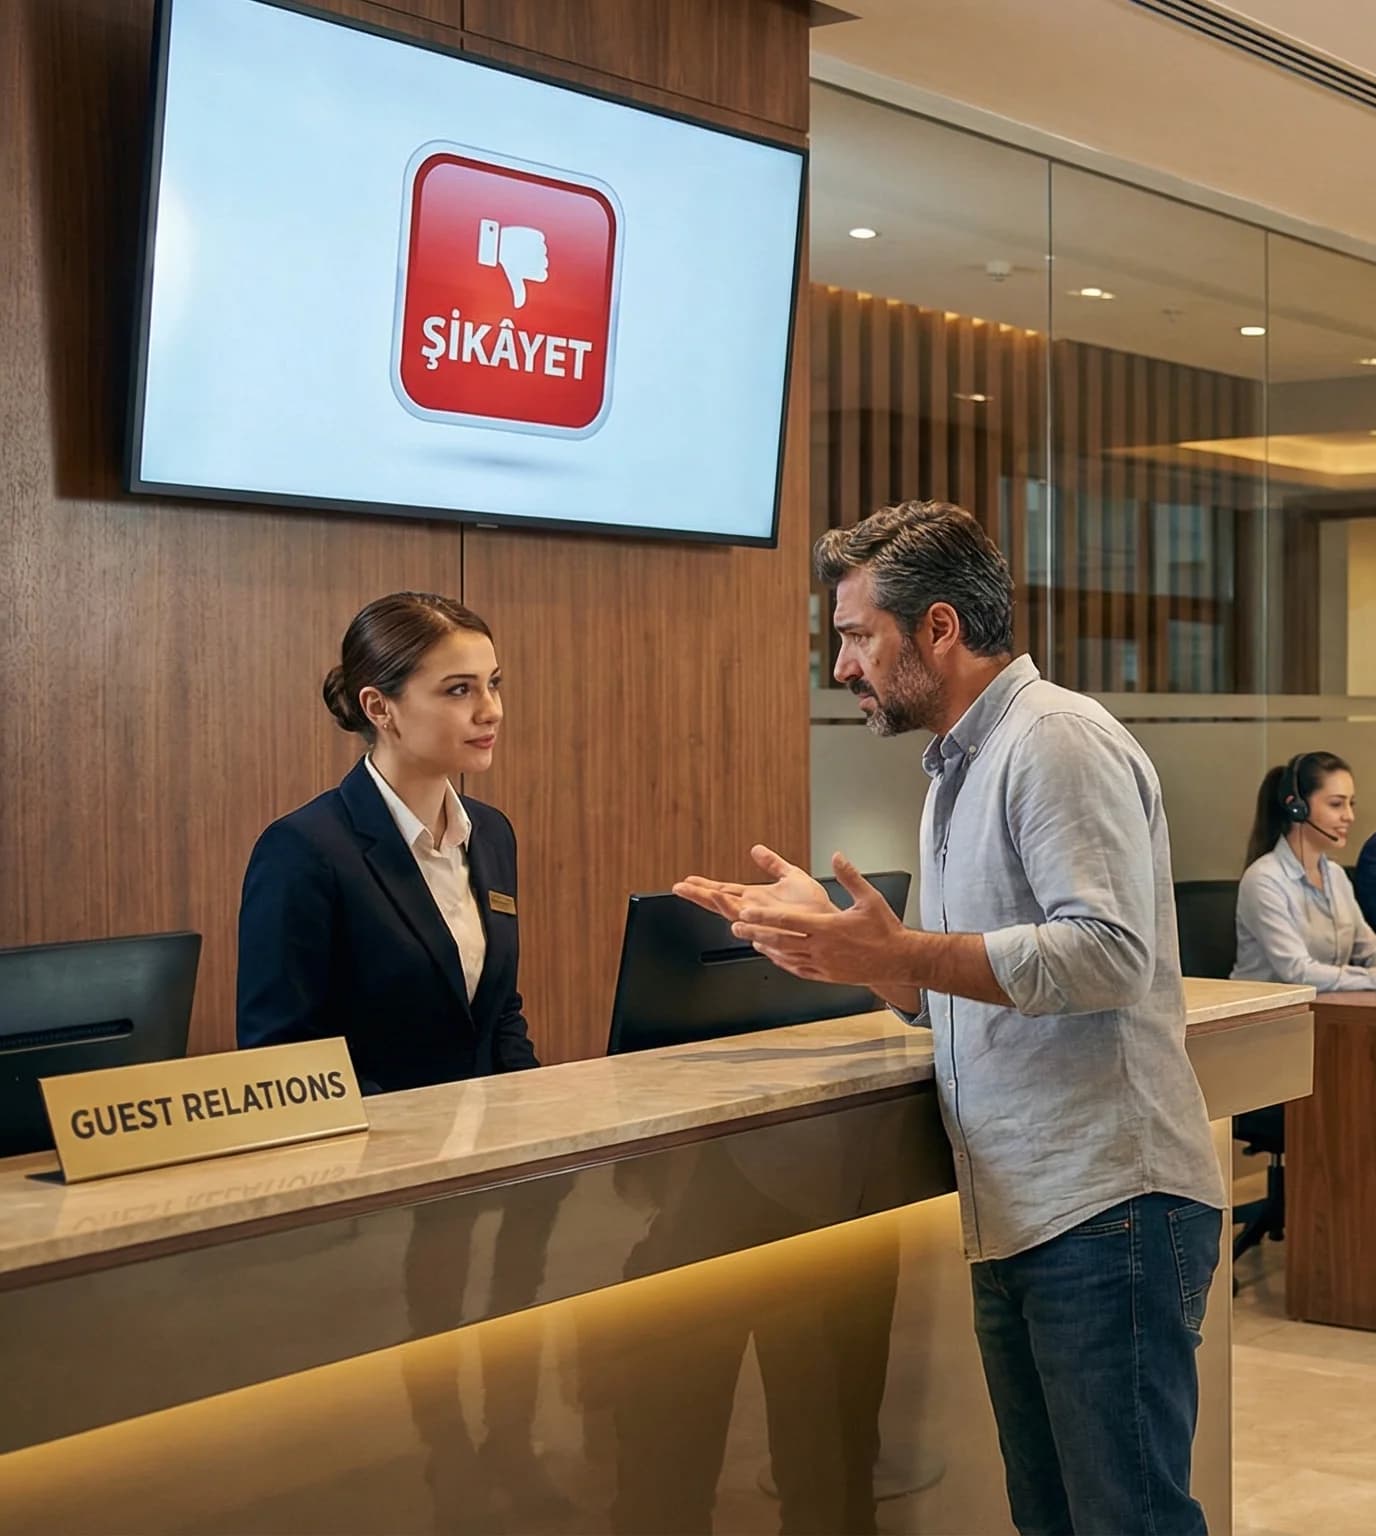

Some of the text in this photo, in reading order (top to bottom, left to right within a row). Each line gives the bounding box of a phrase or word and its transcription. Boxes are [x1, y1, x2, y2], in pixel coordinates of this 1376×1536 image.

[421, 308, 593, 380] ŞİKÂYET
[71, 1071, 347, 1140] GUEST RELATIONS
